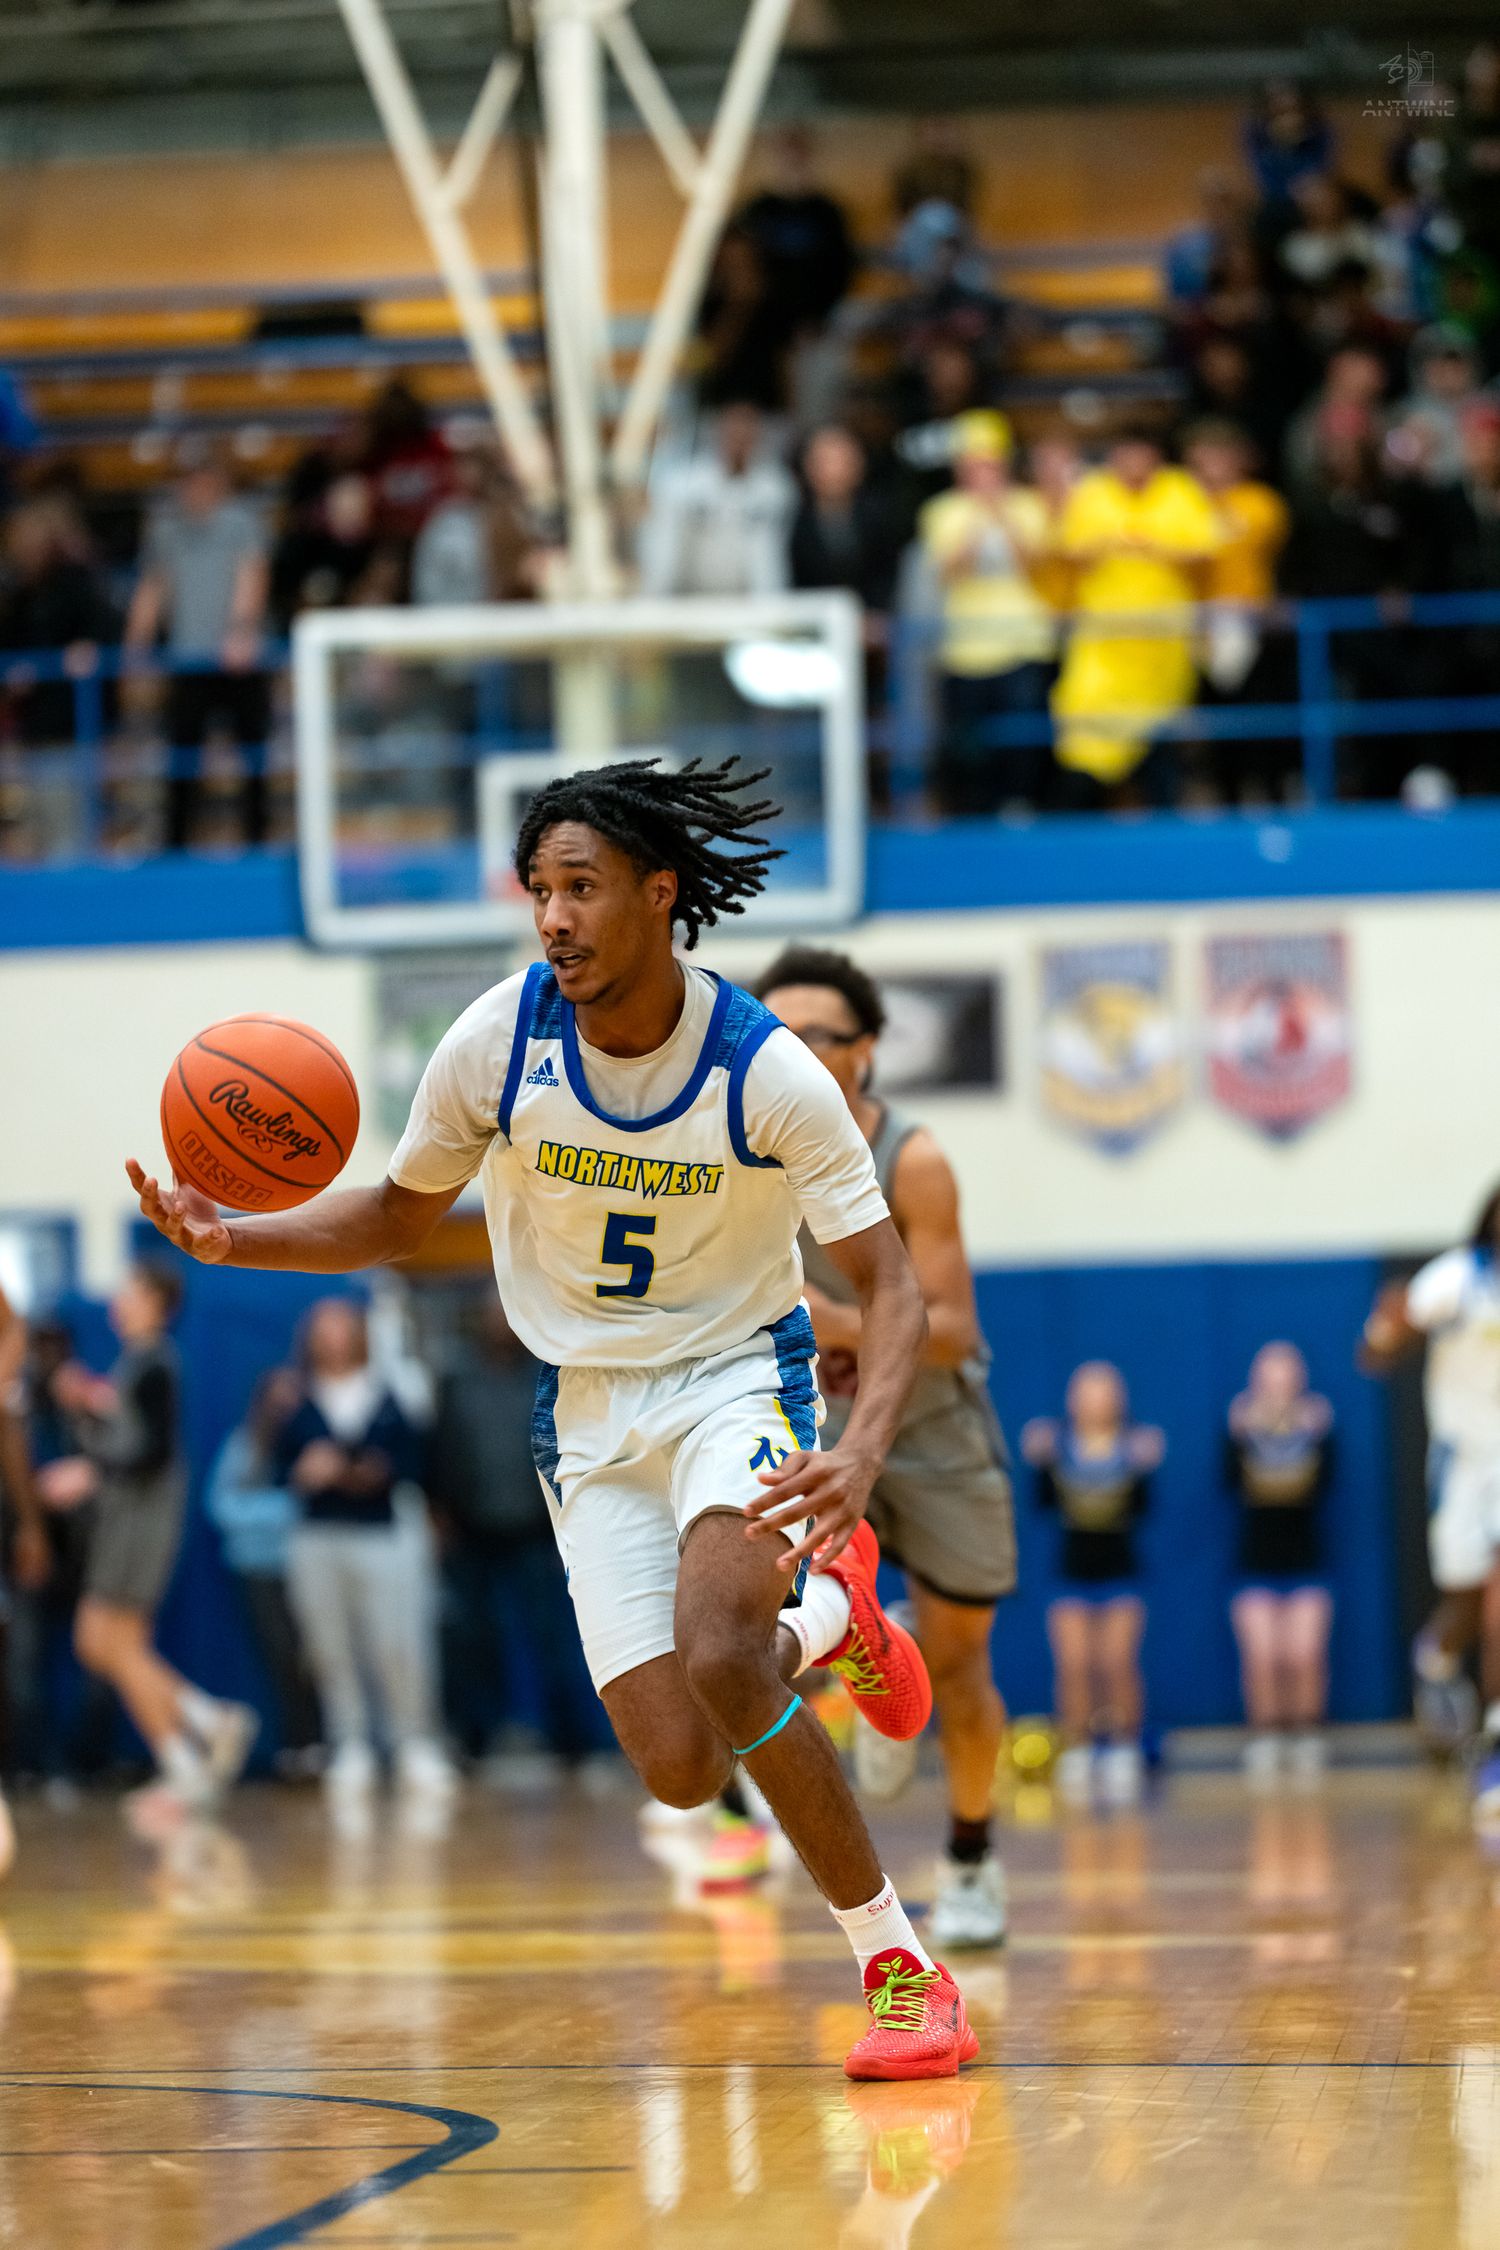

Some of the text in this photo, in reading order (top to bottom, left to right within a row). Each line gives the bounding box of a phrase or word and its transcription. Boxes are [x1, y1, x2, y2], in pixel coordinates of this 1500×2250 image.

[526, 1075, 559, 1087] adidas
[208, 1080, 321, 1161] Rawlings
[179, 1130, 273, 1206] OHSAA
[535, 1140, 725, 1199] NORTHWEST
[596, 1211, 657, 1298] 5
